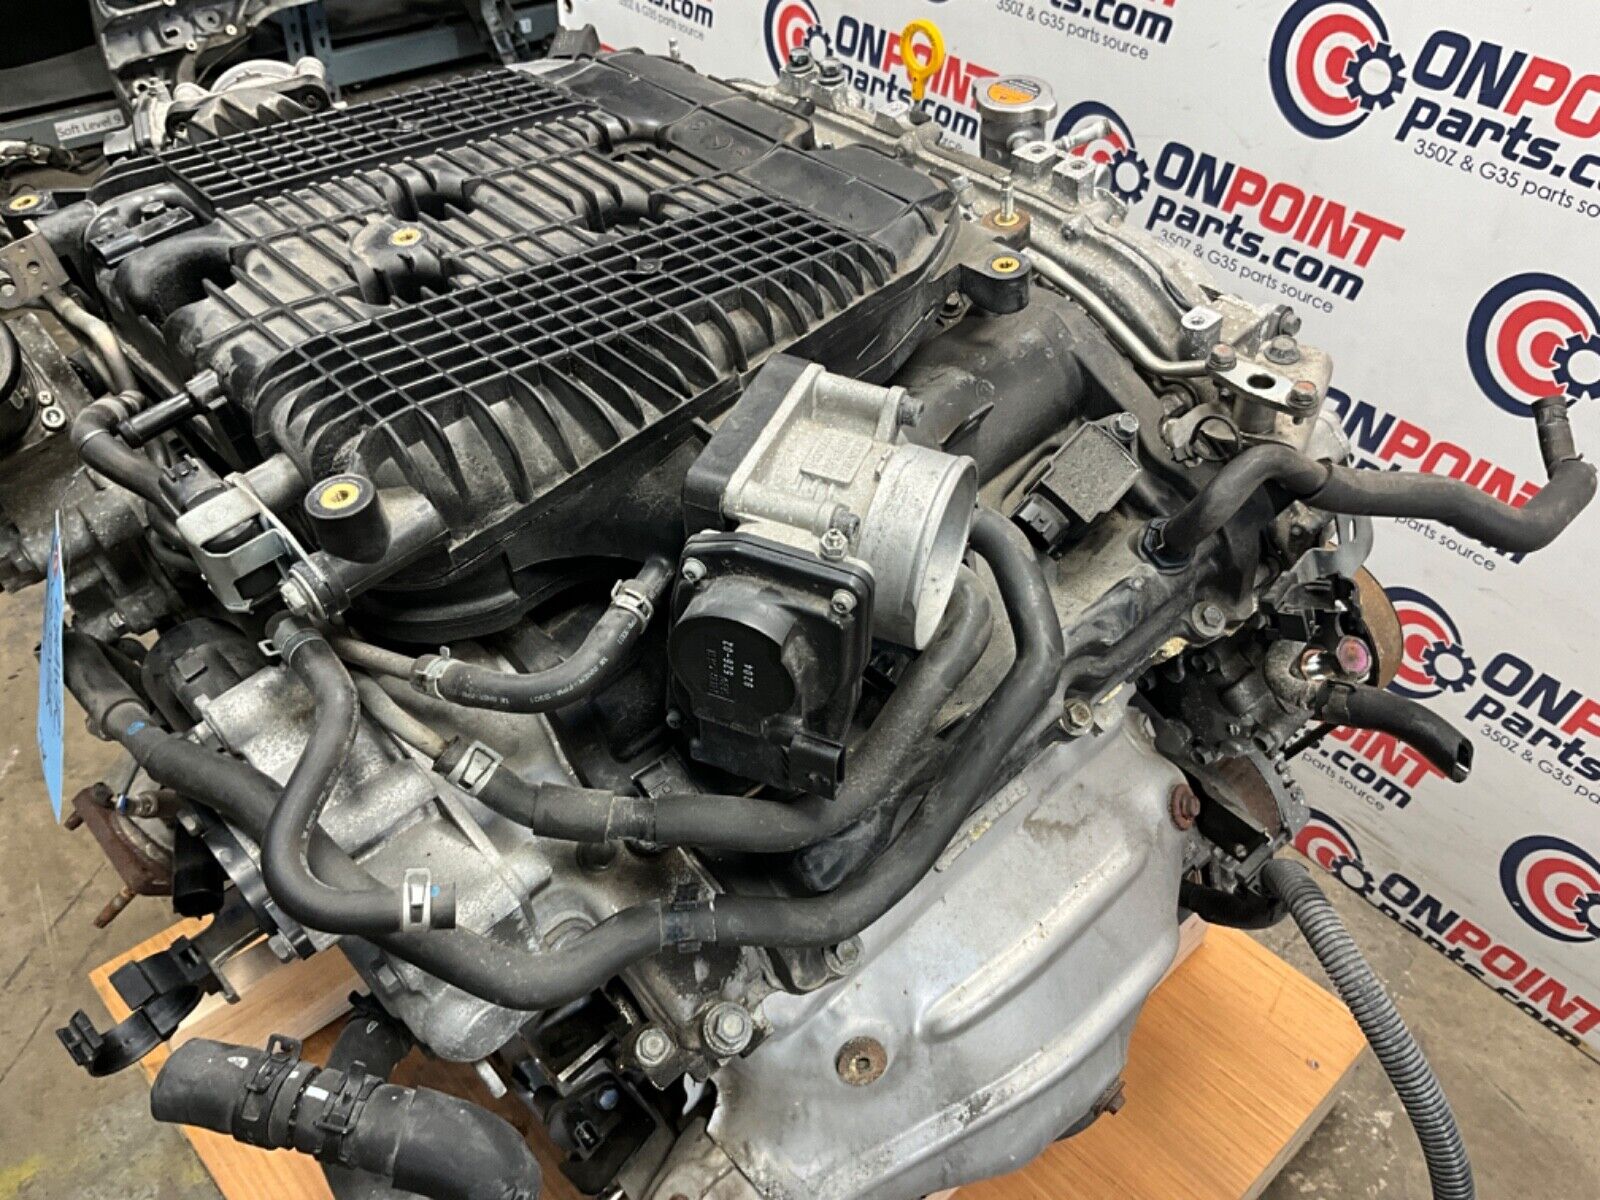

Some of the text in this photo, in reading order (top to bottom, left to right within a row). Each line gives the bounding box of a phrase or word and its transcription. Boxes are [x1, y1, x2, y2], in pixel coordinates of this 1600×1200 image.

[1026, 7, 1035, 21] &
[1039, 10, 1065, 31] G35
[1067, 22, 1100, 43] parts
[1102, 35, 1149, 60] source
[1154, 141, 1405, 268] ONPOINT
[1413, 138, 1459, 167] 350Z
[1459, 155, 1475, 173] &
[1479, 161, 1521, 188] G35
[1521, 180, 1574, 209] parts
[1145, 195, 1365, 301] parts.com
[1207, 250, 1238, 272] G35
[1239, 266, 1277, 291] parts
[1281, 283, 1334, 314] source
[1439, 535, 1496, 571] source
[1301, 751, 1386, 812] parts source
[1480, 722, 1520, 754] 350Z
[1520, 749, 1534, 764] &
[1537, 759, 1575, 787] G35
[1379, 872, 1600, 1035] ONPOINT
